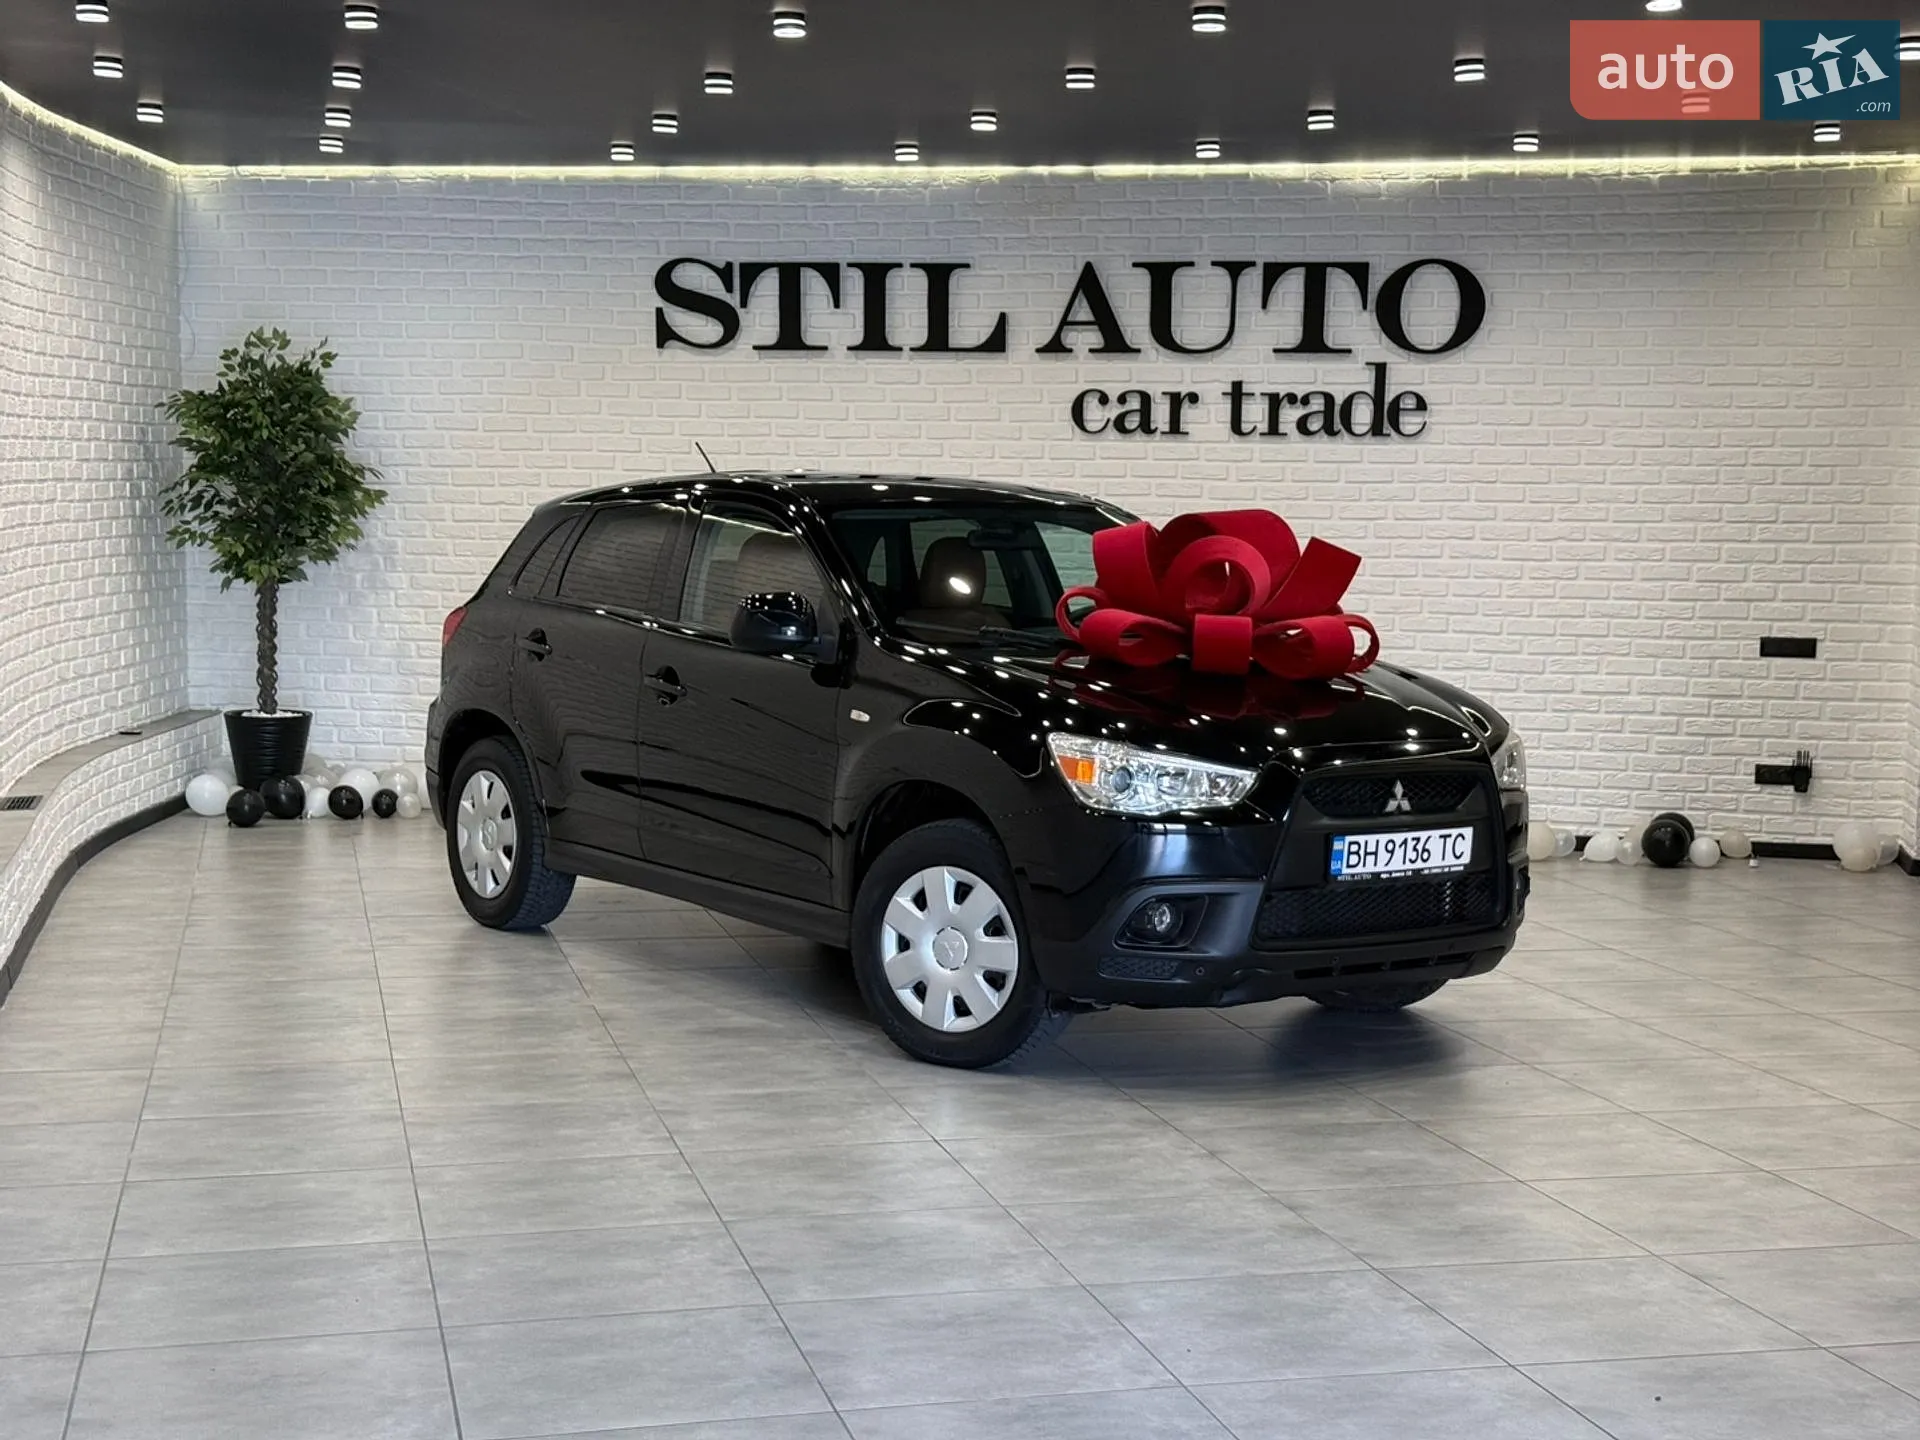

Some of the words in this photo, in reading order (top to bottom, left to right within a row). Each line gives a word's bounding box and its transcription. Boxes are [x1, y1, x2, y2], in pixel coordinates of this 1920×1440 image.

[654, 257, 1007, 354] STIL
[1035, 258, 1486, 355] AUTO
[1071, 388, 1200, 437] car
[1222, 362, 1428, 438] trade
[1345, 838, 1380, 869] BH
[1384, 834, 1433, 867] 9136
[1438, 833, 1466, 862] TC
